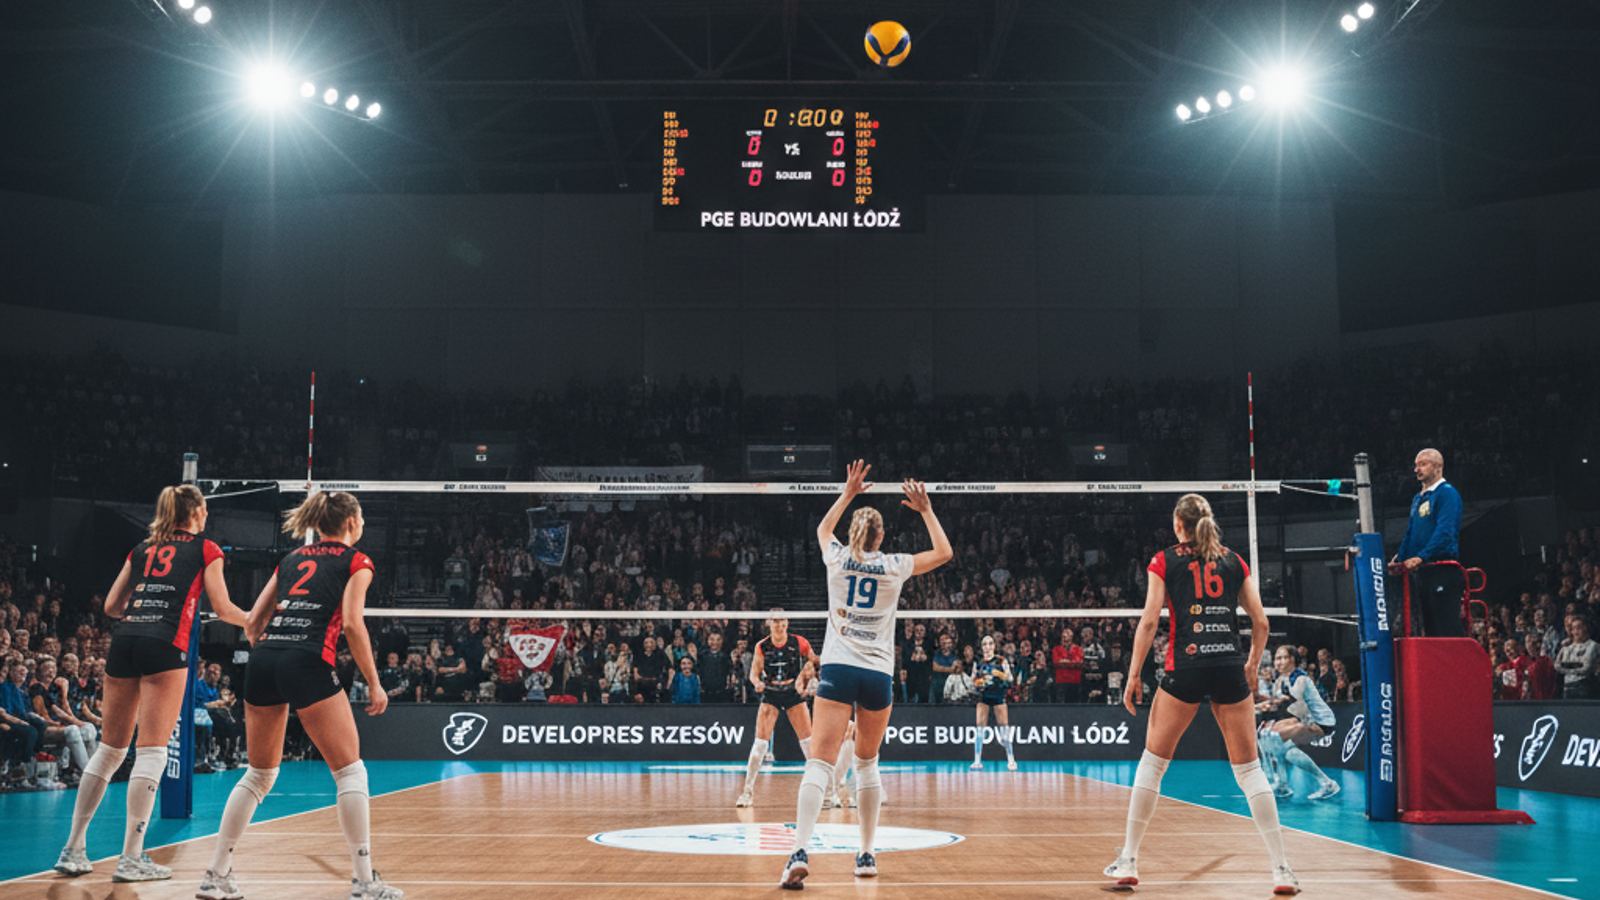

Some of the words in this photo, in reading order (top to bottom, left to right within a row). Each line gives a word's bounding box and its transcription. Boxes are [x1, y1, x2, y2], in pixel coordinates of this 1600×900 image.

[748, 168, 763, 187] 0
[831, 168, 846, 187] 0
[701, 211, 734, 227] PGE
[740, 211, 848, 227] BUDOWLANI
[288, 559, 318, 596] 2
[1187, 559, 1224, 599] 16
[844, 574, 878, 609] 19
[502, 725, 644, 745] DEVELOPRES
[650, 721, 744, 745] RZESÓW
[885, 726, 928, 744] PGE
[1071, 721, 1130, 744] ŁÓDŹ
